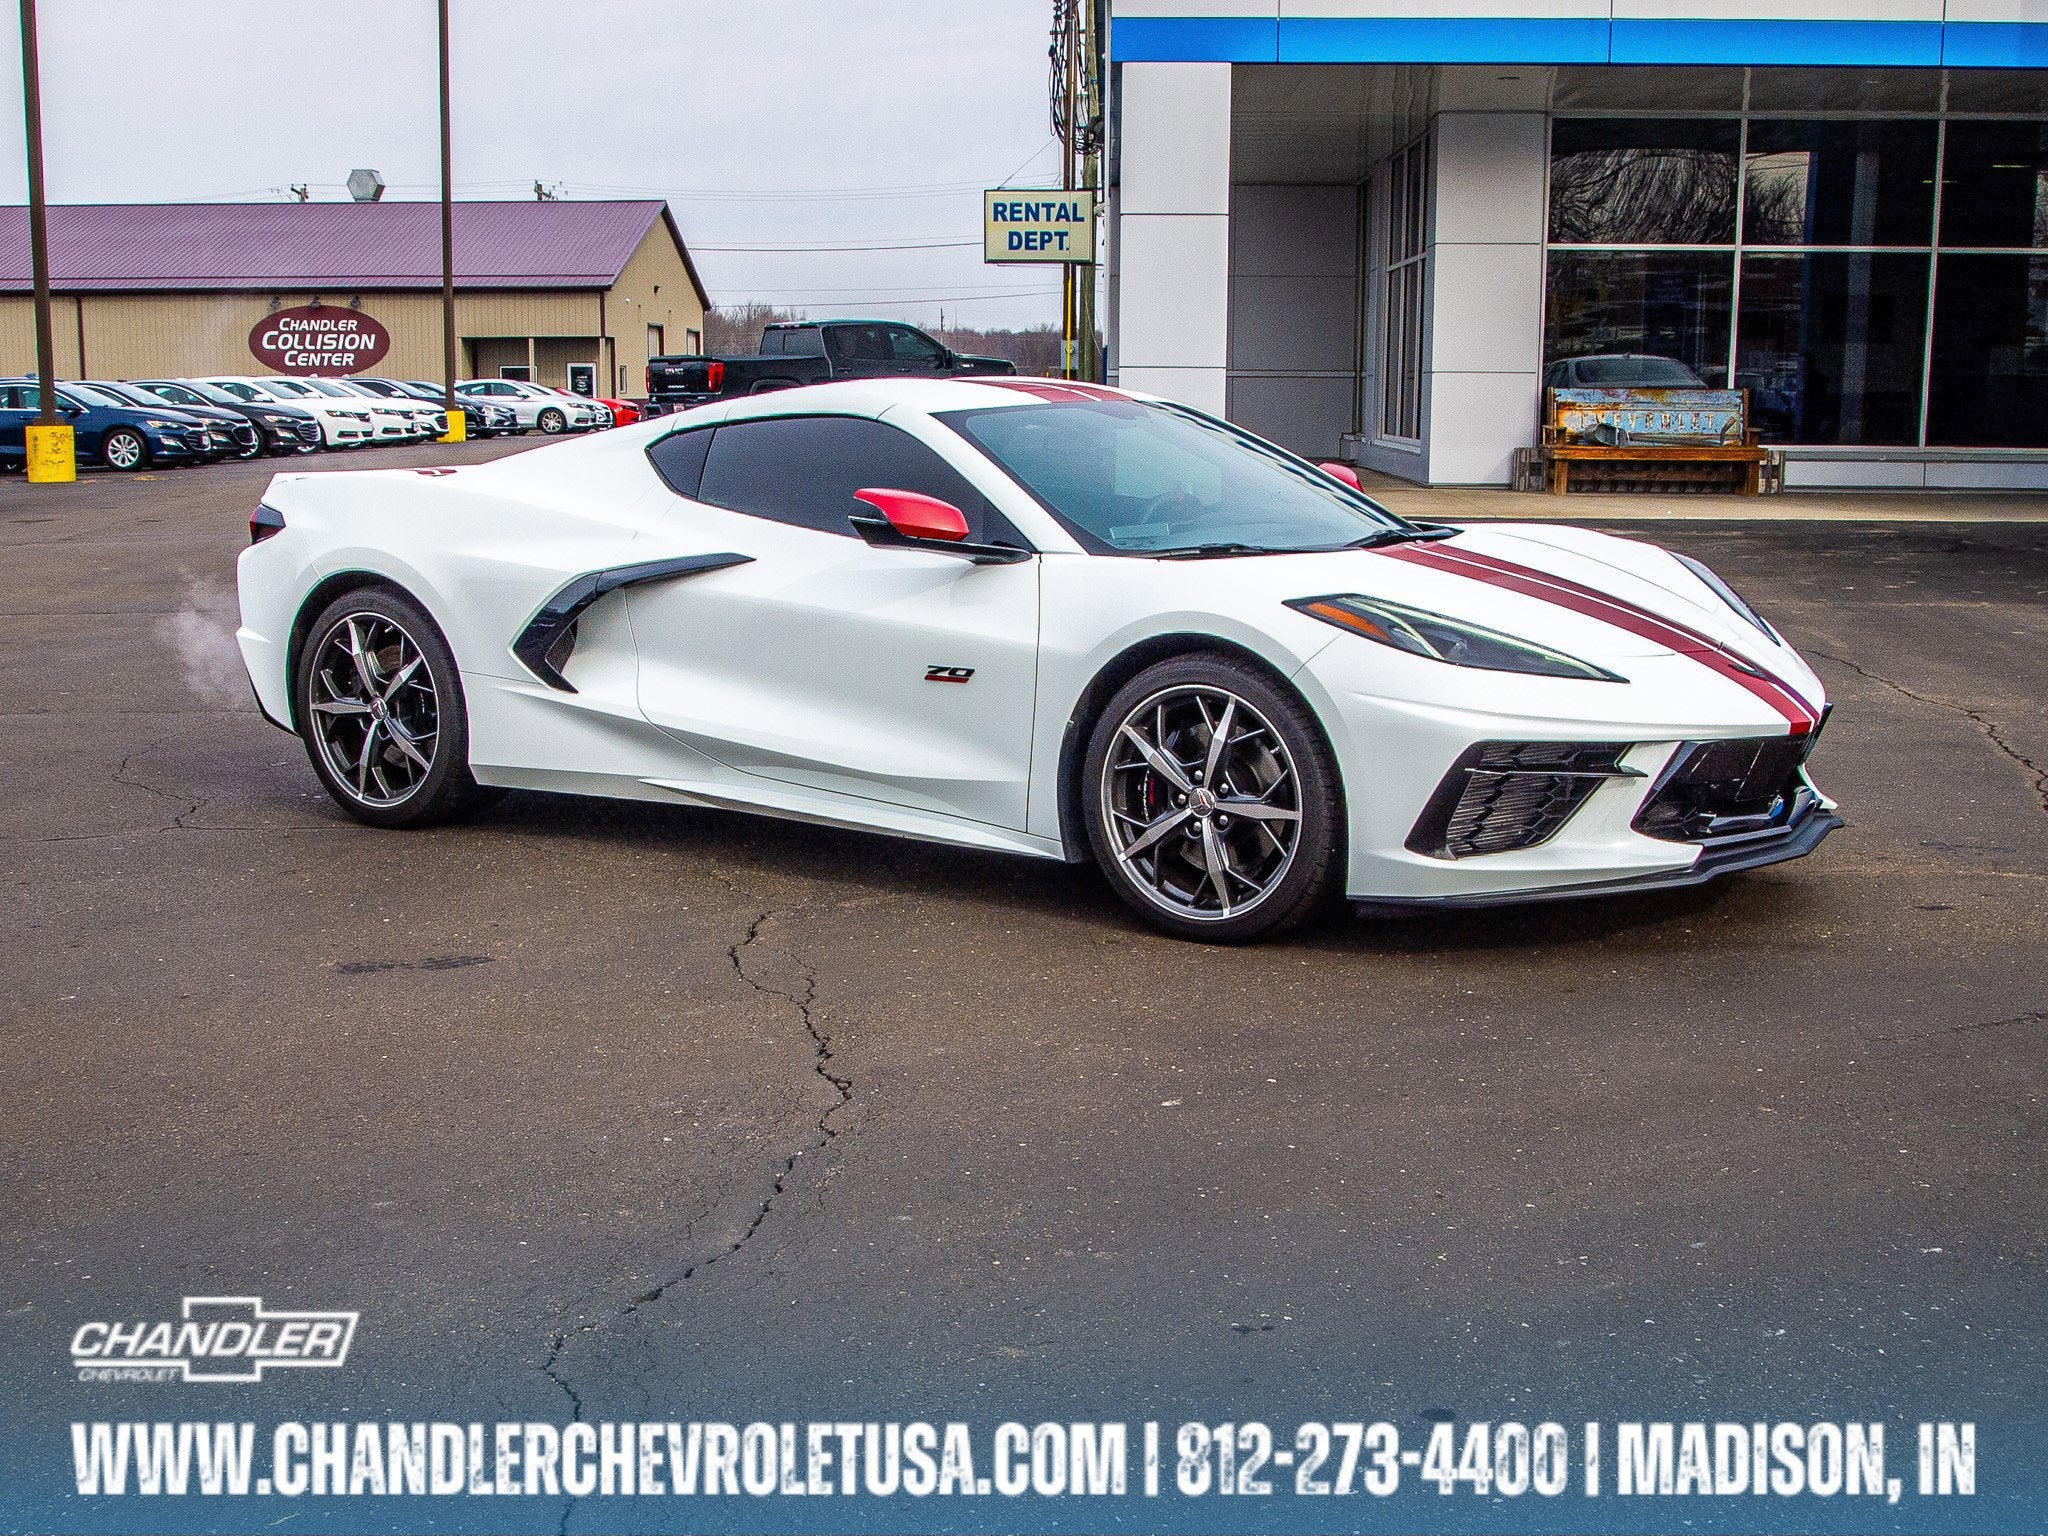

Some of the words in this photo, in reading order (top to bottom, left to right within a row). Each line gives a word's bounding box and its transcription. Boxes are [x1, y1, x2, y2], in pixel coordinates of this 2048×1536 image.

[992, 202, 1085, 222] RENTAL
[1007, 230, 1070, 251] DEPT.
[279, 317, 358, 331] CHANDLER
[262, 331, 376, 350] COLLISION
[284, 350, 355, 367] CENTER
